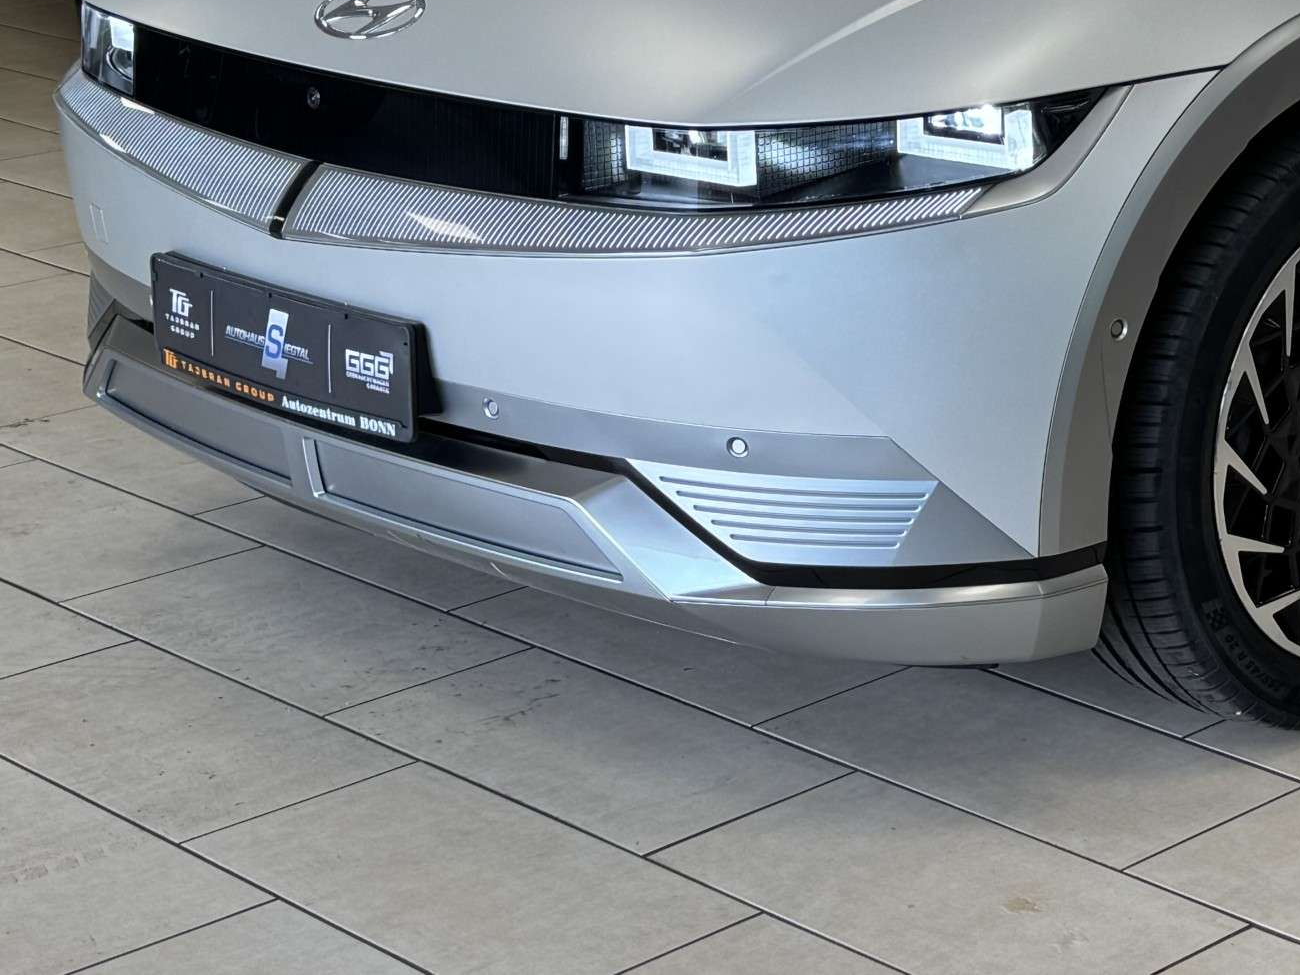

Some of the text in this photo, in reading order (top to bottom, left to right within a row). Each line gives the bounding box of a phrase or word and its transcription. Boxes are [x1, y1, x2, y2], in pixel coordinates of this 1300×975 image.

[225, 325, 265, 346] AUTOHAUS
[281, 395, 356, 427] Autozentrum
[360, 416, 397, 437] BONN
